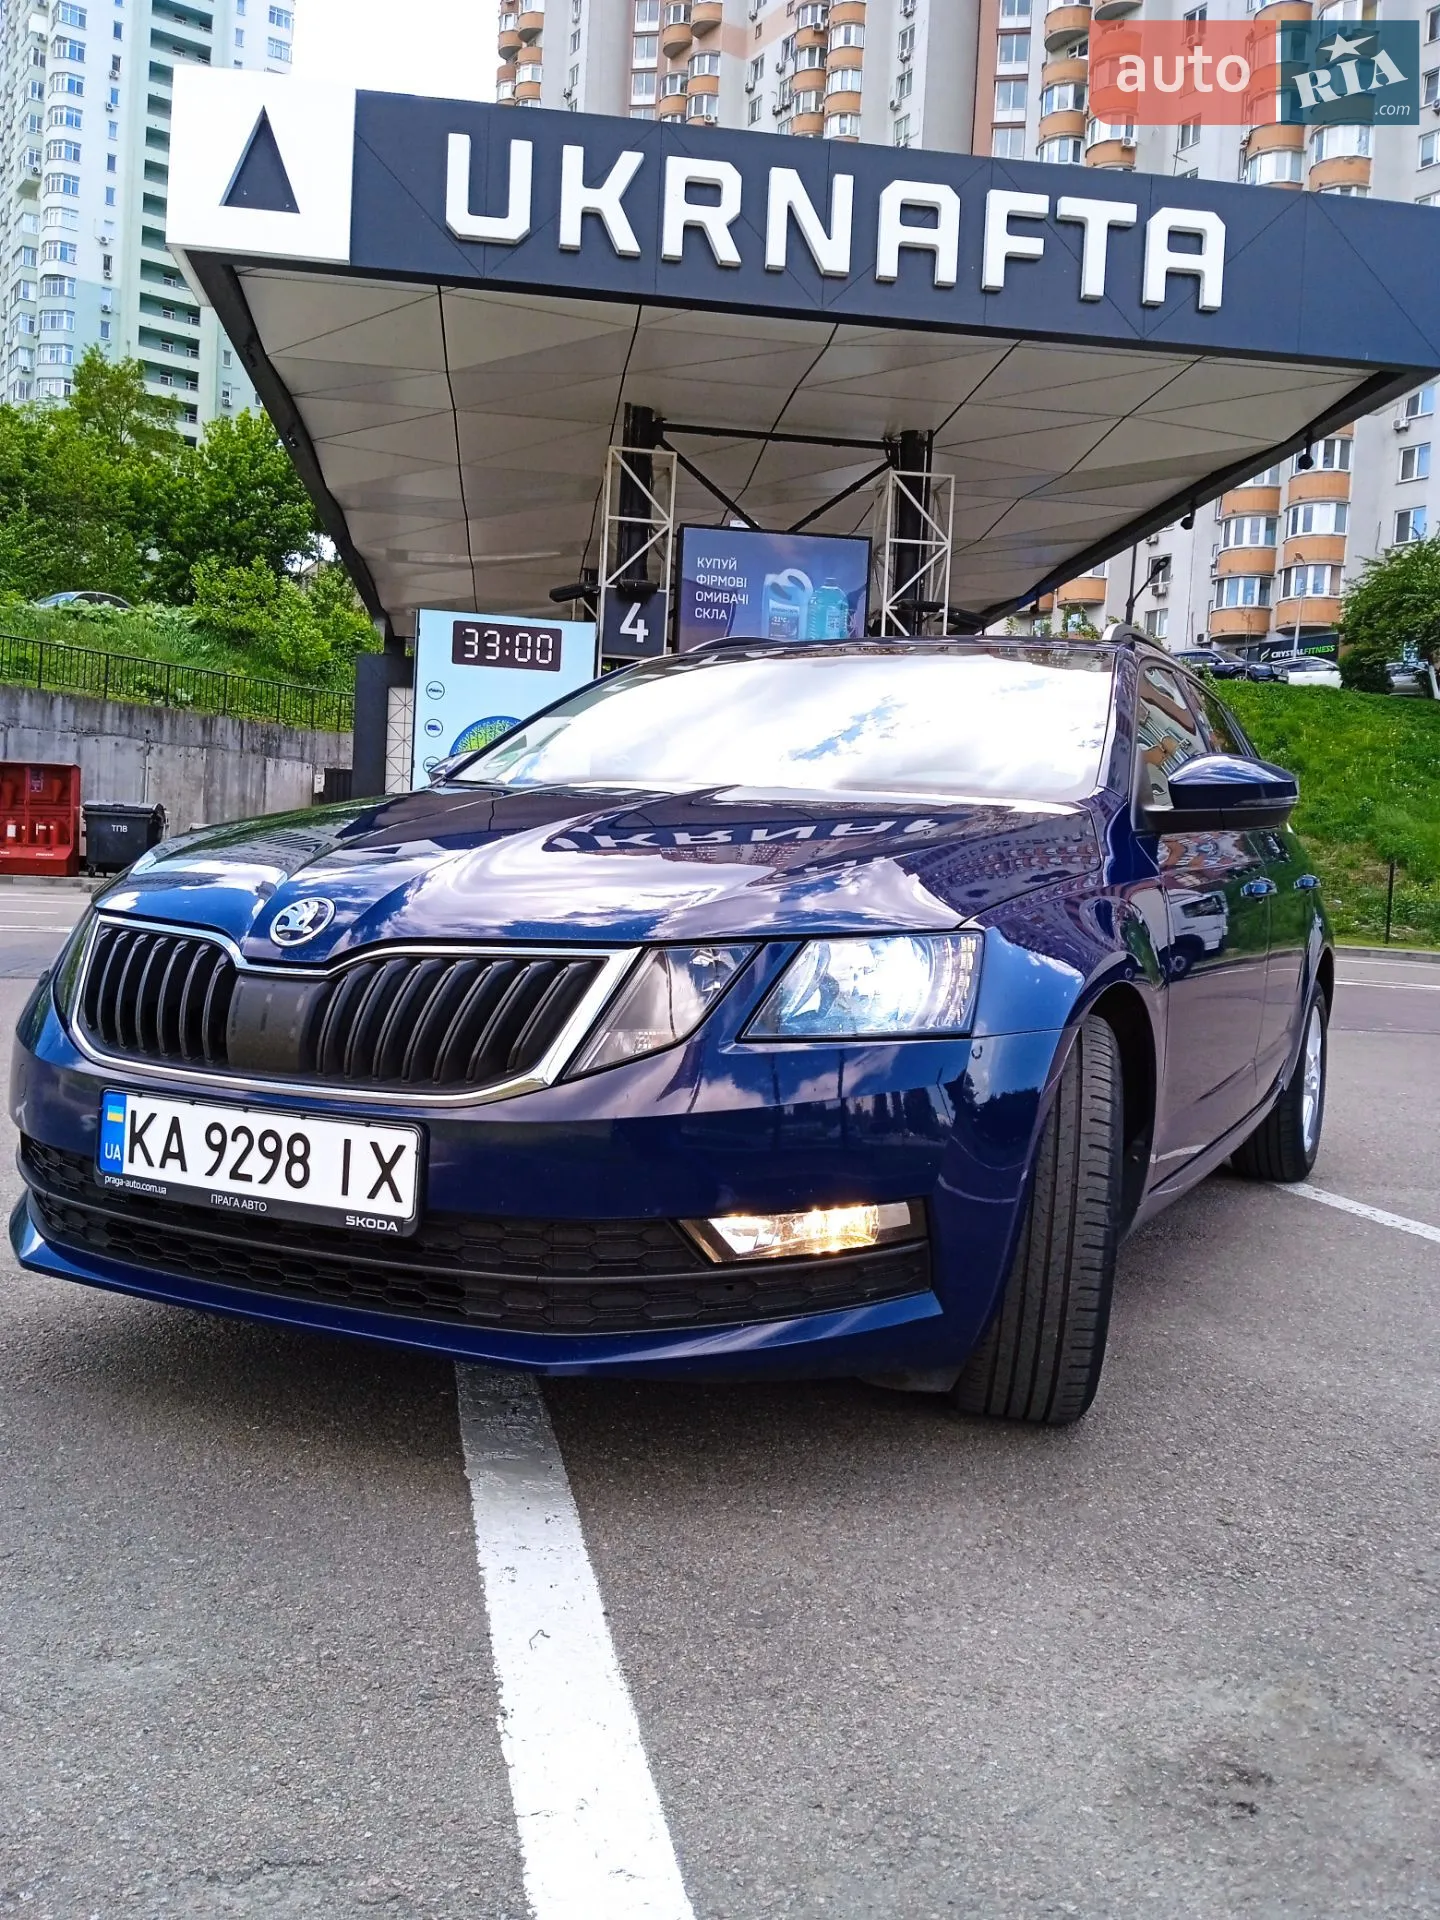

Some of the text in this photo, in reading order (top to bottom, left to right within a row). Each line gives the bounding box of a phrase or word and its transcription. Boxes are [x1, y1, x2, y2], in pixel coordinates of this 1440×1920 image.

[445, 132, 1226, 311] UKRNAFTA
[697, 556, 737, 571] КУПУЙ
[696, 574, 747, 588] ФІРМОВІ
[695, 591, 749, 605] ОМИВАЧІ
[619, 602, 649, 643] 4
[695, 607, 727, 620] СКЛА
[463, 628, 553, 664] 33:00
[105, 1142, 121, 1161] UA
[128, 1110, 406, 1203] KA 9298 IX
[104, 1175, 167, 1195] praga-auto.com.ua
[210, 1194, 267, 1212] ПРАГА АВТО
[345, 1215, 398, 1232] SKODA
